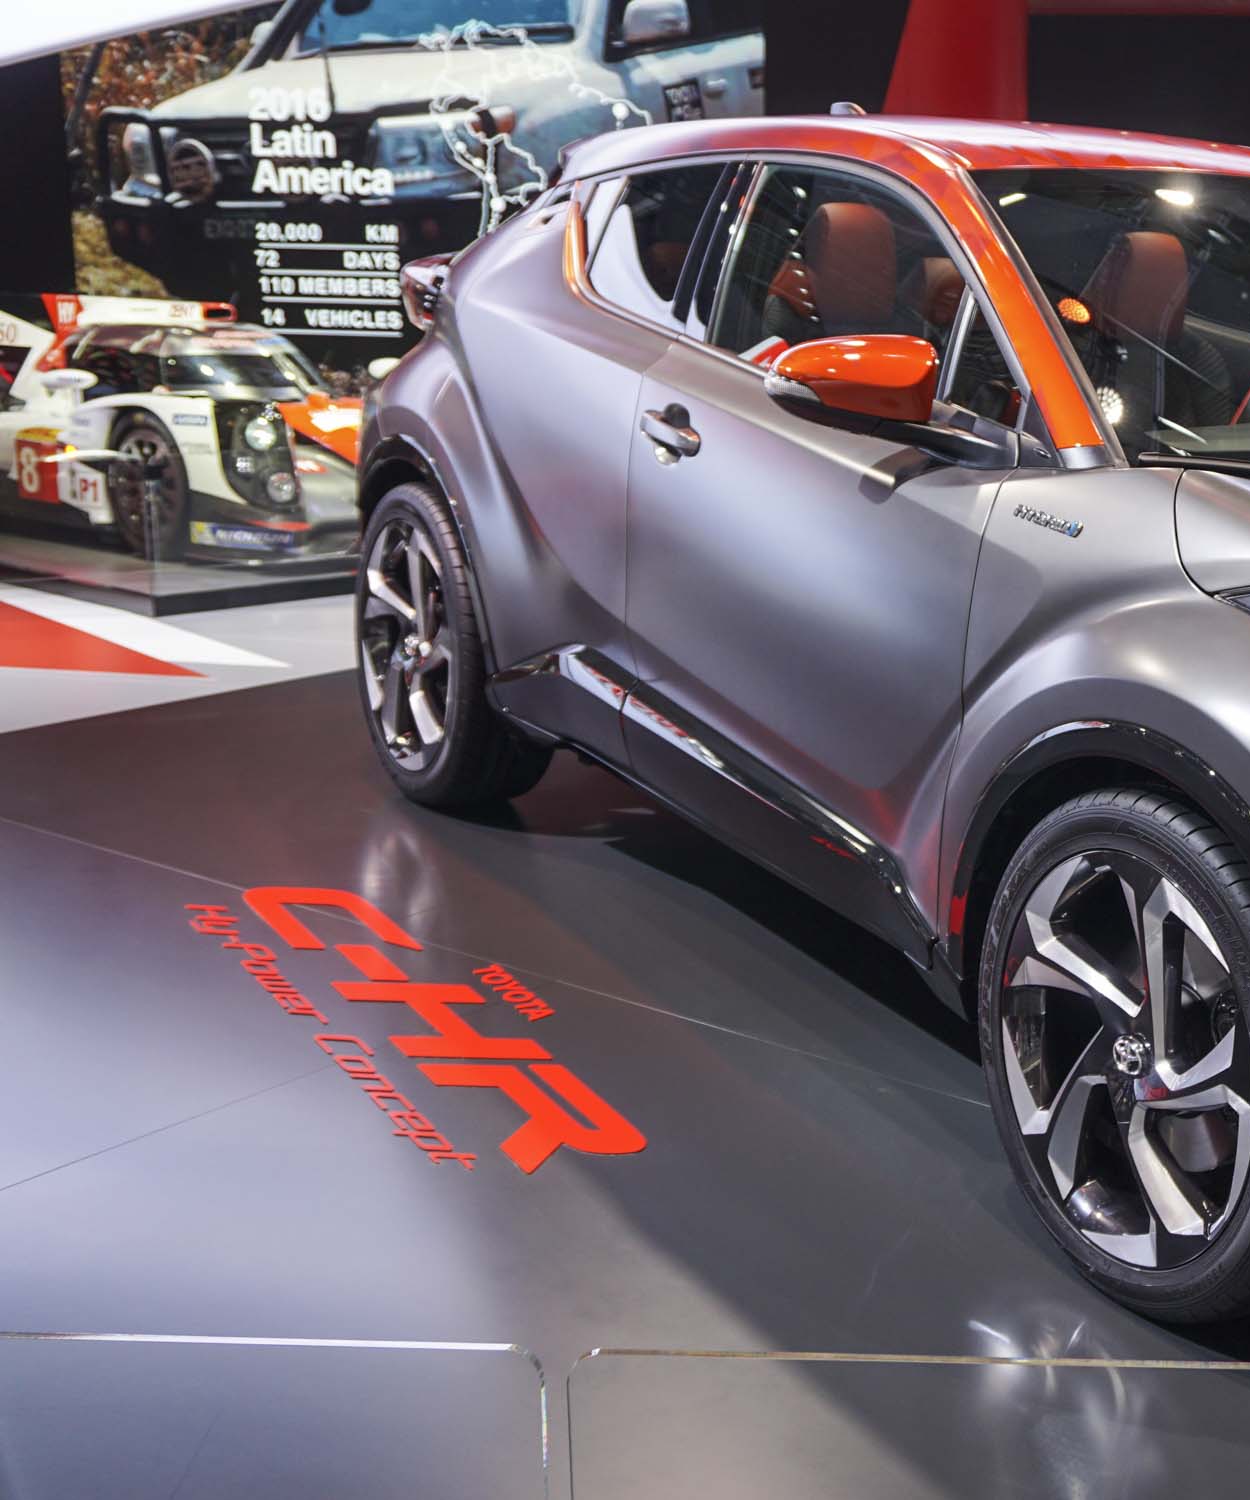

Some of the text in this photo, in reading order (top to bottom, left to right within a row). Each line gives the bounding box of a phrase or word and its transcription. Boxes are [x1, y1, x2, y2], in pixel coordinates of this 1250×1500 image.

[249, 88, 332, 122] 2016
[250, 122, 337, 158] Latin
[252, 159, 395, 196] America
[365, 224, 399, 243] KM
[254, 250, 400, 270] 72 DAYS
[259, 277, 402, 298] 110 MEMBERS
[261, 308, 404, 329] 14 VEHICLES
[20, 446, 40, 493] 8
[80, 477, 98, 502] P1
[472, 963, 556, 1022] TOYOTA
[184, 903, 477, 1170] Hy-Power Concept
[243, 886, 647, 1174] C-HR
